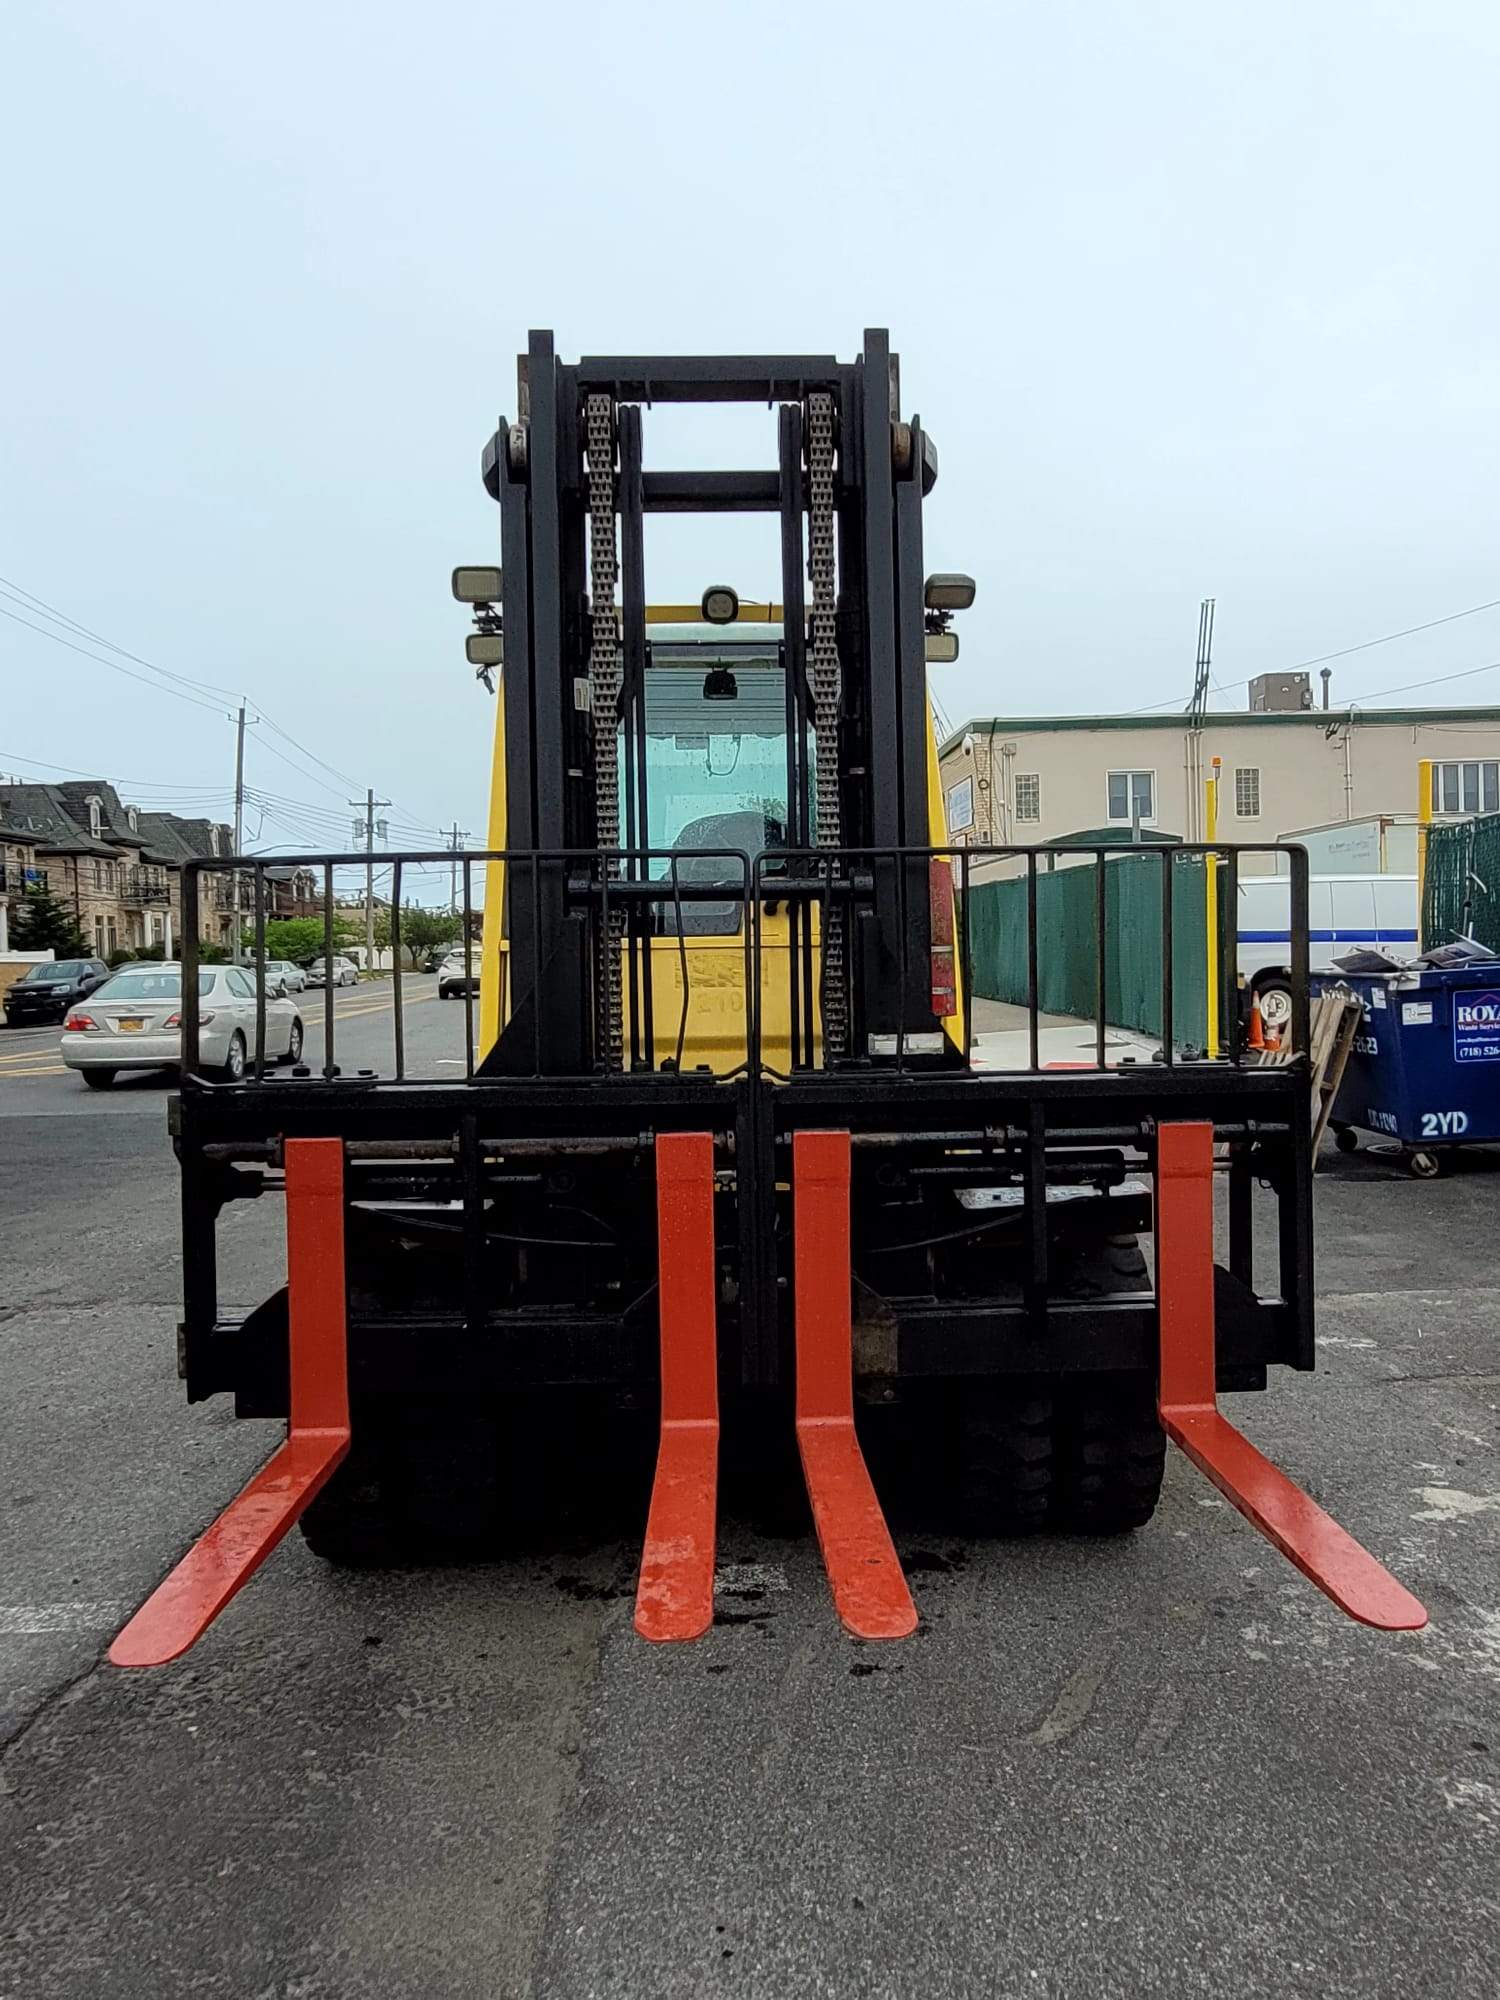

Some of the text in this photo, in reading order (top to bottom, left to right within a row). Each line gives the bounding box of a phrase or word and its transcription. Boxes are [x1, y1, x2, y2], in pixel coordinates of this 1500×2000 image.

[1457, 1004, 1500, 1023] ROY
[1460, 1047, 1482, 1058] (718)
[1421, 1111, 1468, 1136] 2YD
